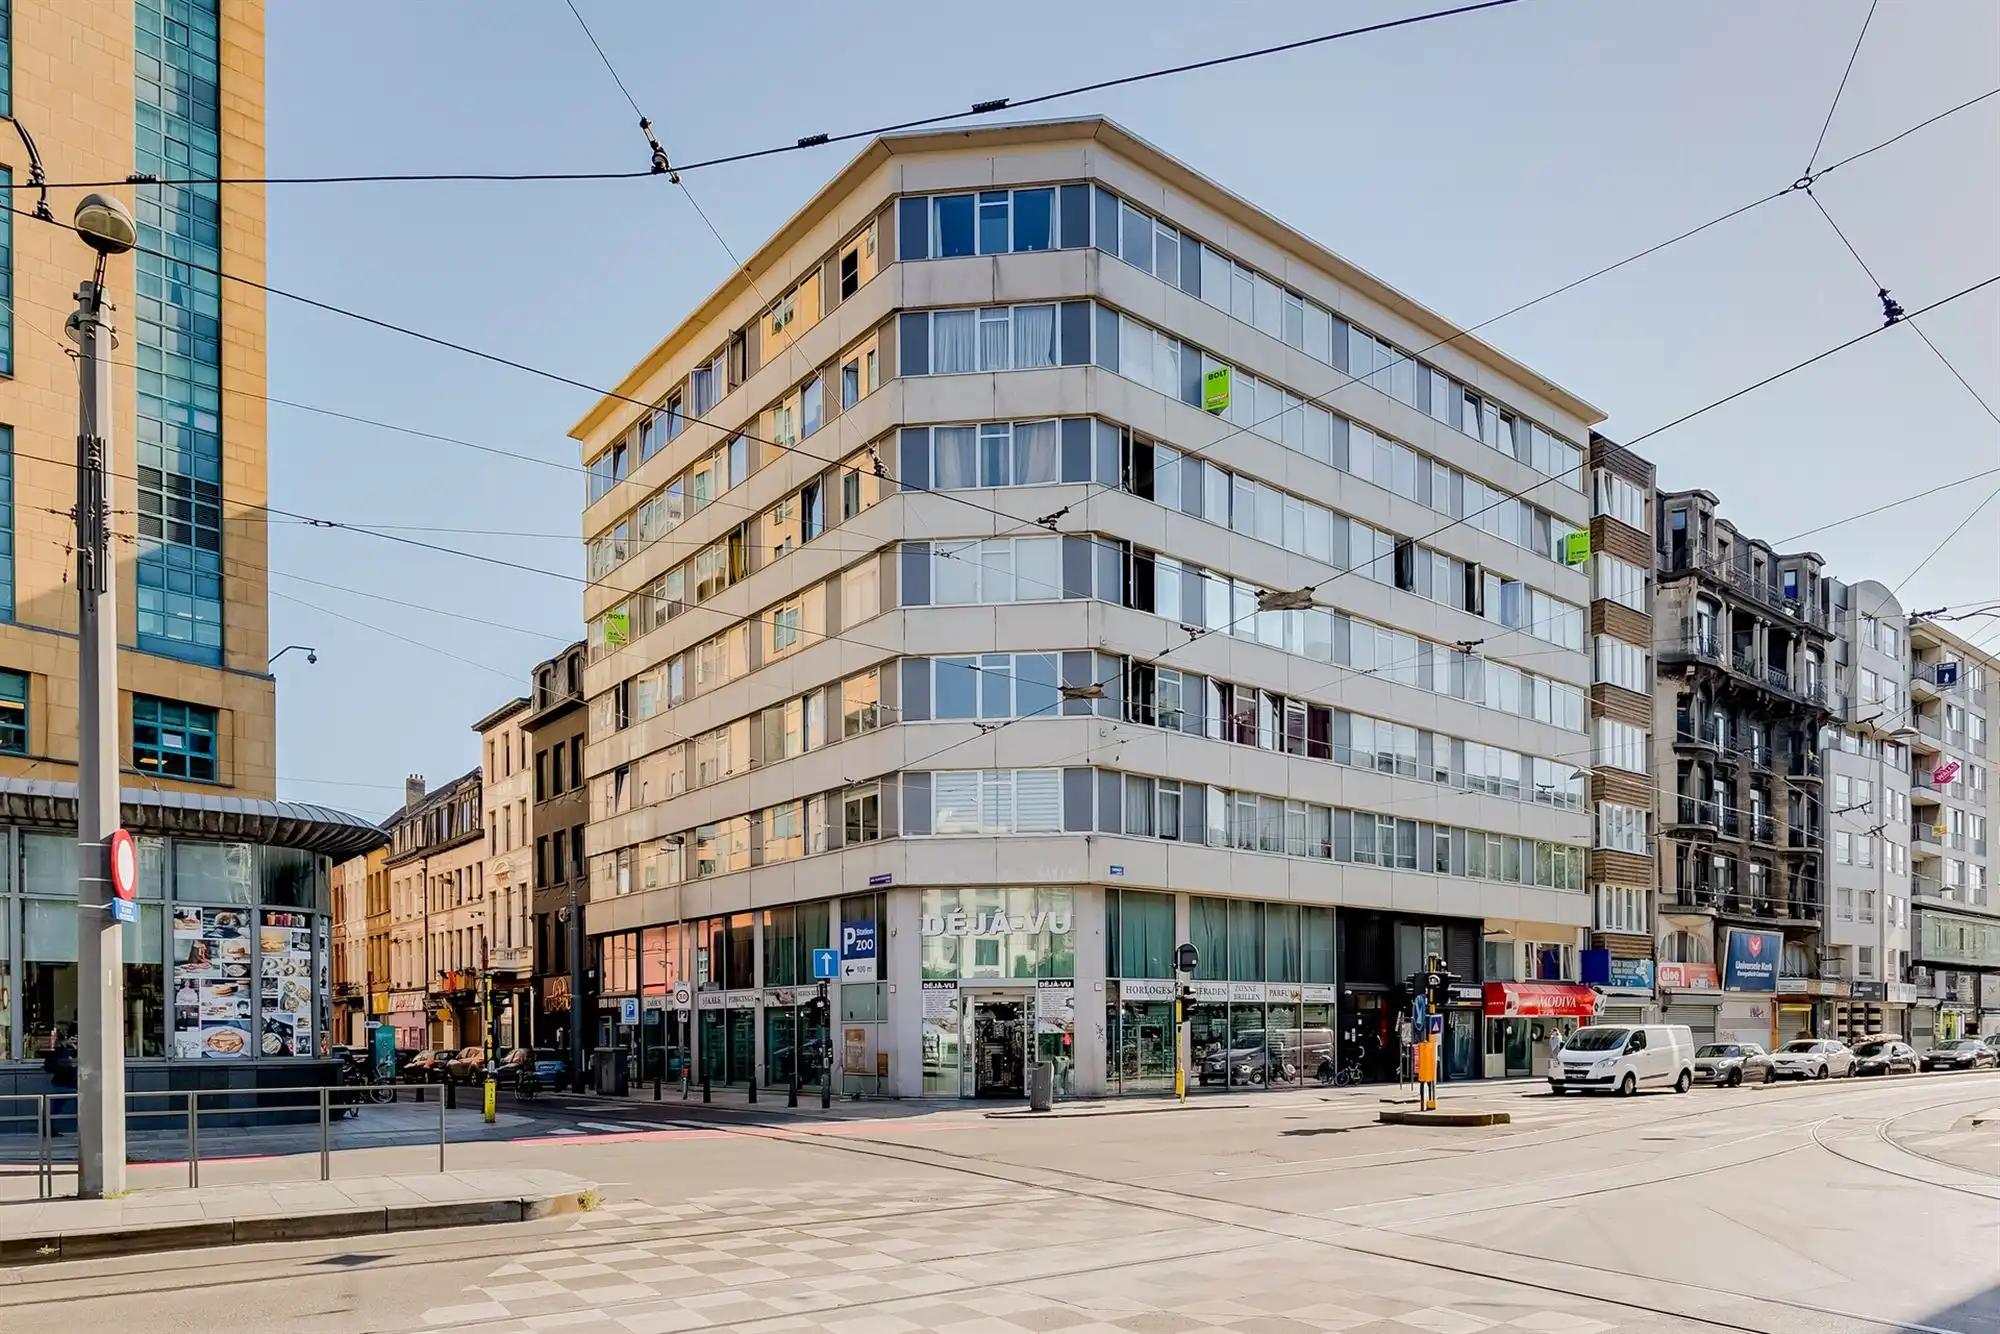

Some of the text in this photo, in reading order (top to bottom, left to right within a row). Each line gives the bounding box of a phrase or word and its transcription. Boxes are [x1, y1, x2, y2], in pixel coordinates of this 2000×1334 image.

[1208, 369, 1229, 380] BOLT
[856, 928, 874, 936] Station
[843, 927, 856, 955] P
[856, 939, 874, 951] ZOO
[1761, 962, 1773, 971] Kerk
[1125, 985, 1172, 995] HORLOGES
[1193, 986, 1227, 996] IERADEN
[1539, 995, 1576, 1008] MODIVA
